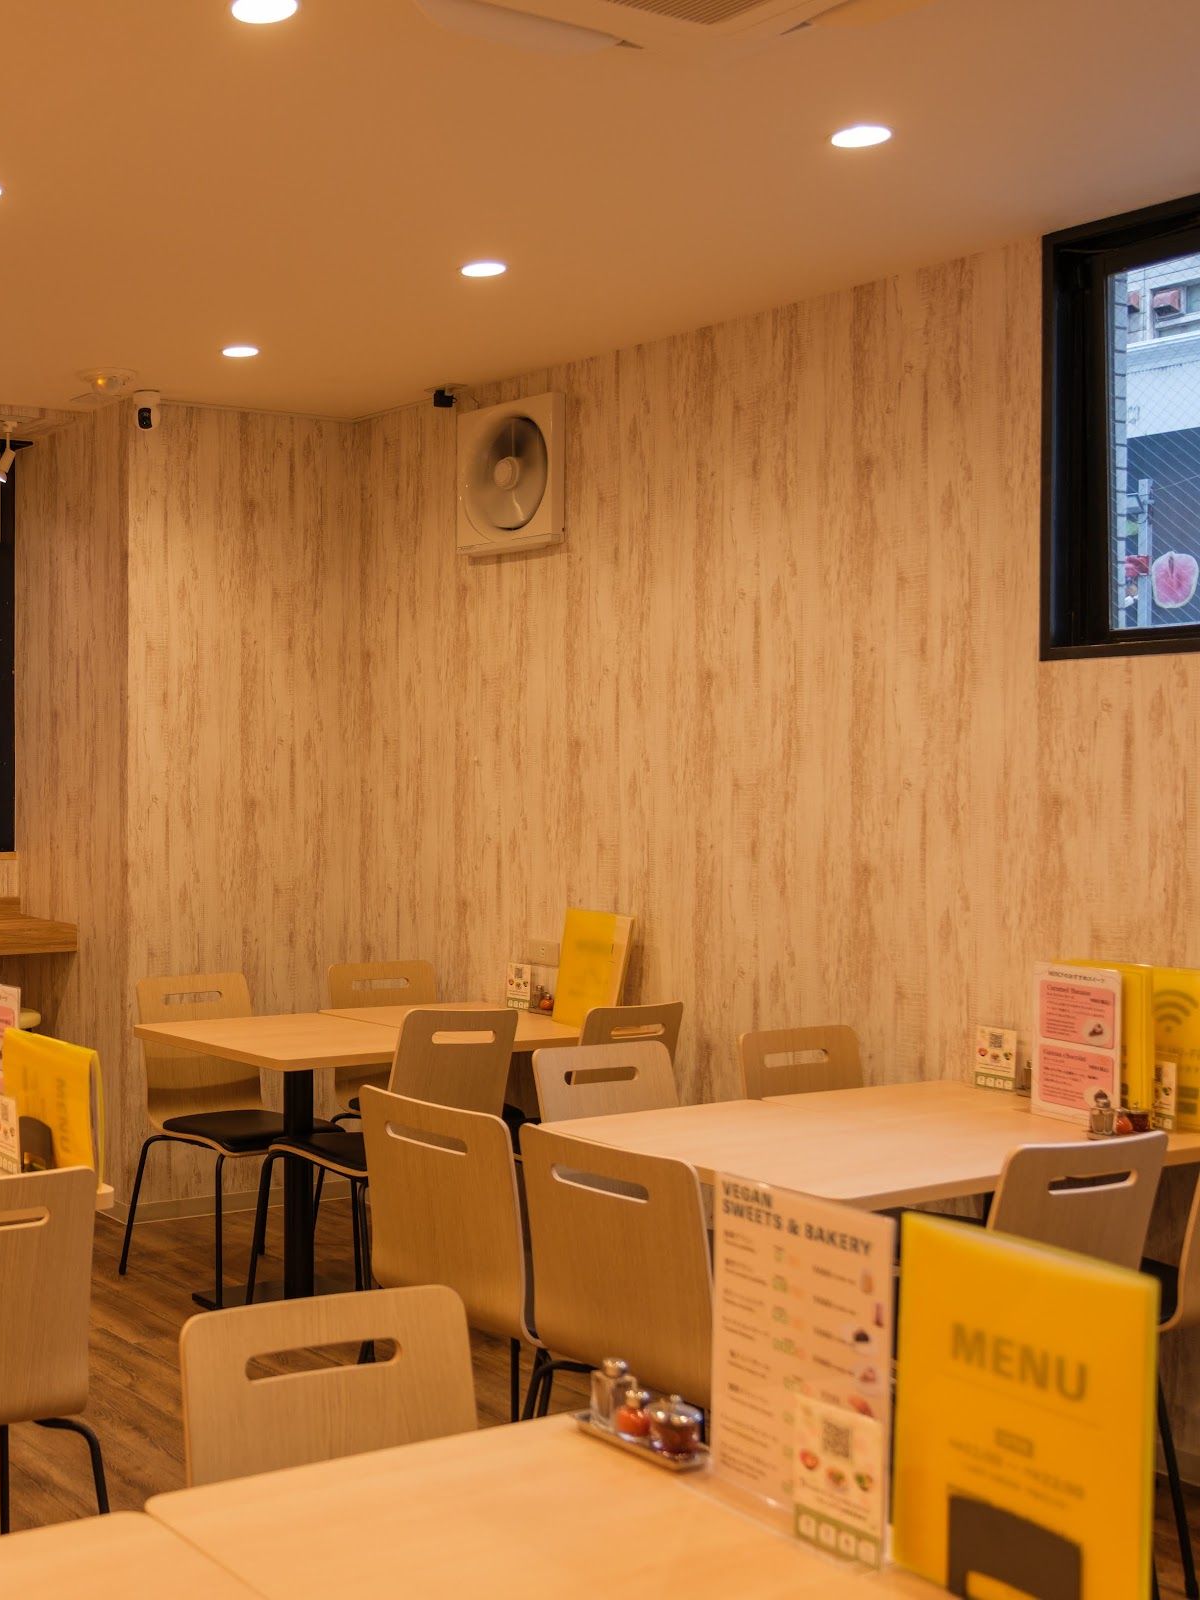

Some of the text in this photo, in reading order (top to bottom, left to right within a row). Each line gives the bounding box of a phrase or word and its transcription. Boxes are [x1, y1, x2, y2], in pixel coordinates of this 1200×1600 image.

[722, 1181, 773, 1208] VEGAN
[722, 1199, 872, 1256] SWEETS & BAKERY
[951, 1321, 1087, 1403] MENU
